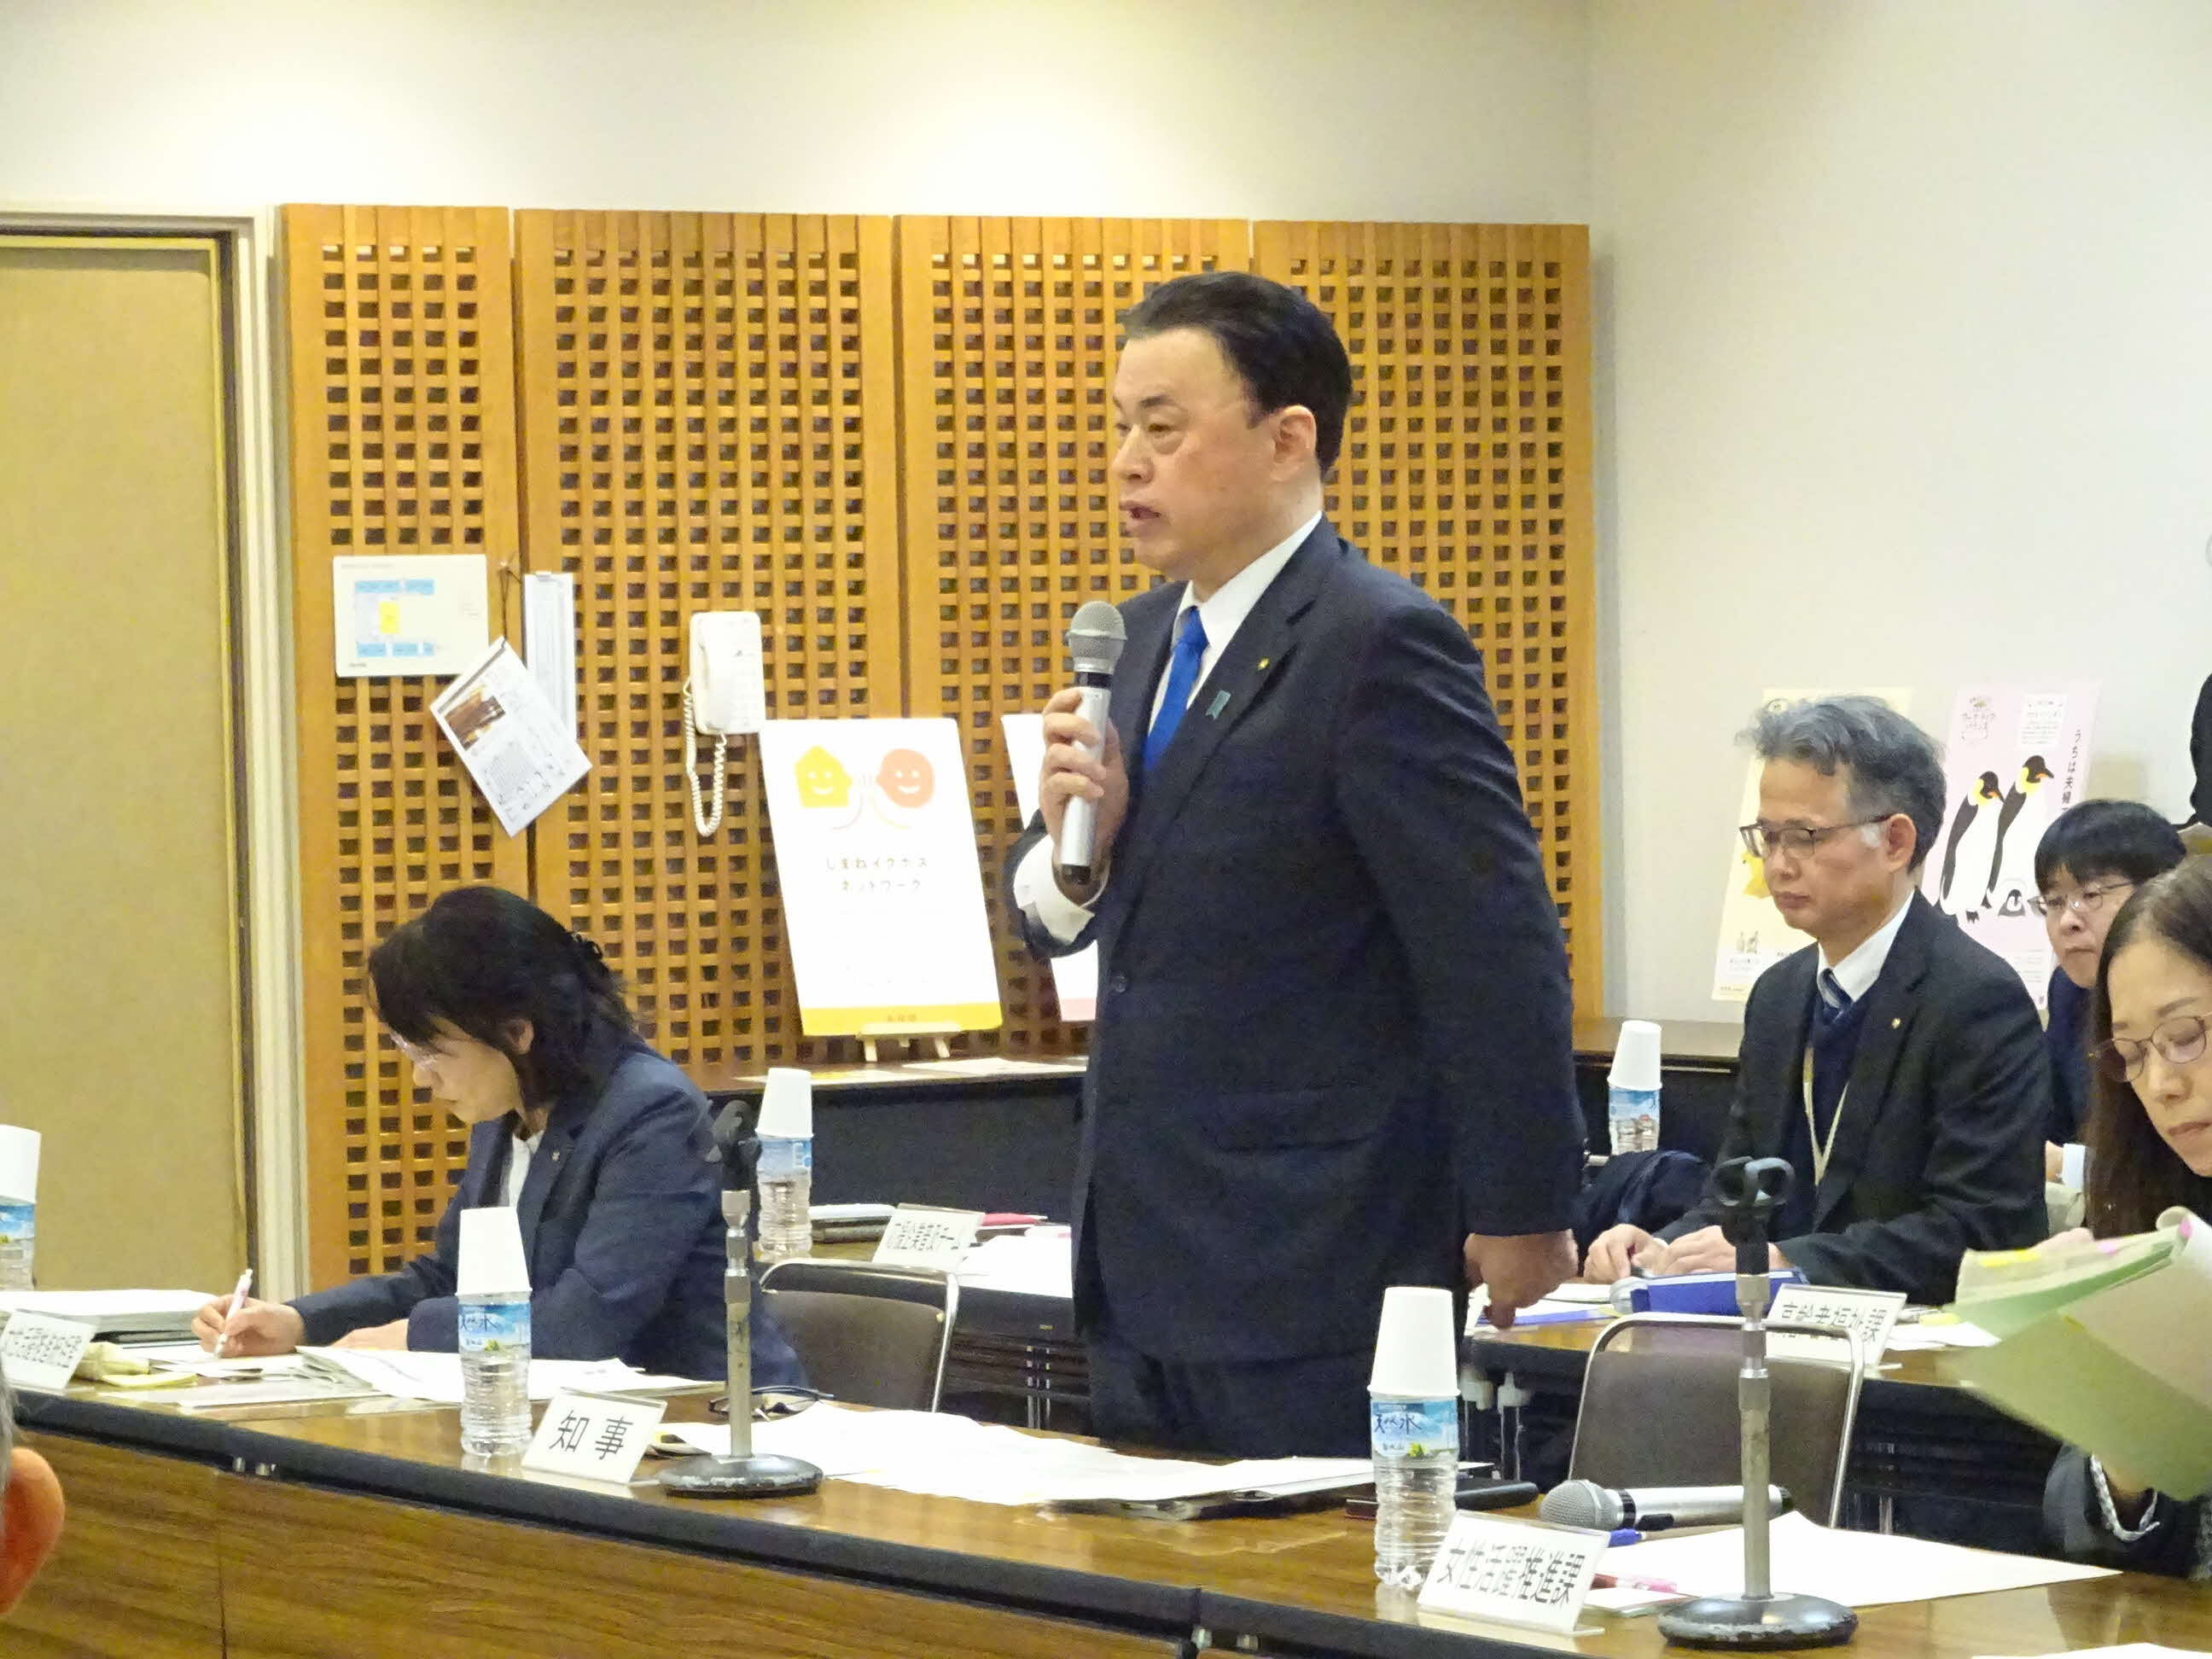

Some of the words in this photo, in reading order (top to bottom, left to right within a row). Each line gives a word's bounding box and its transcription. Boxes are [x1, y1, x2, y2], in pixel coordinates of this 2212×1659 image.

[2061, 729, 2081, 811] うちは夫婦
[549, 1410, 634, 1460] 知事
[1436, 1539, 1586, 1609] 女性活躍推進課
